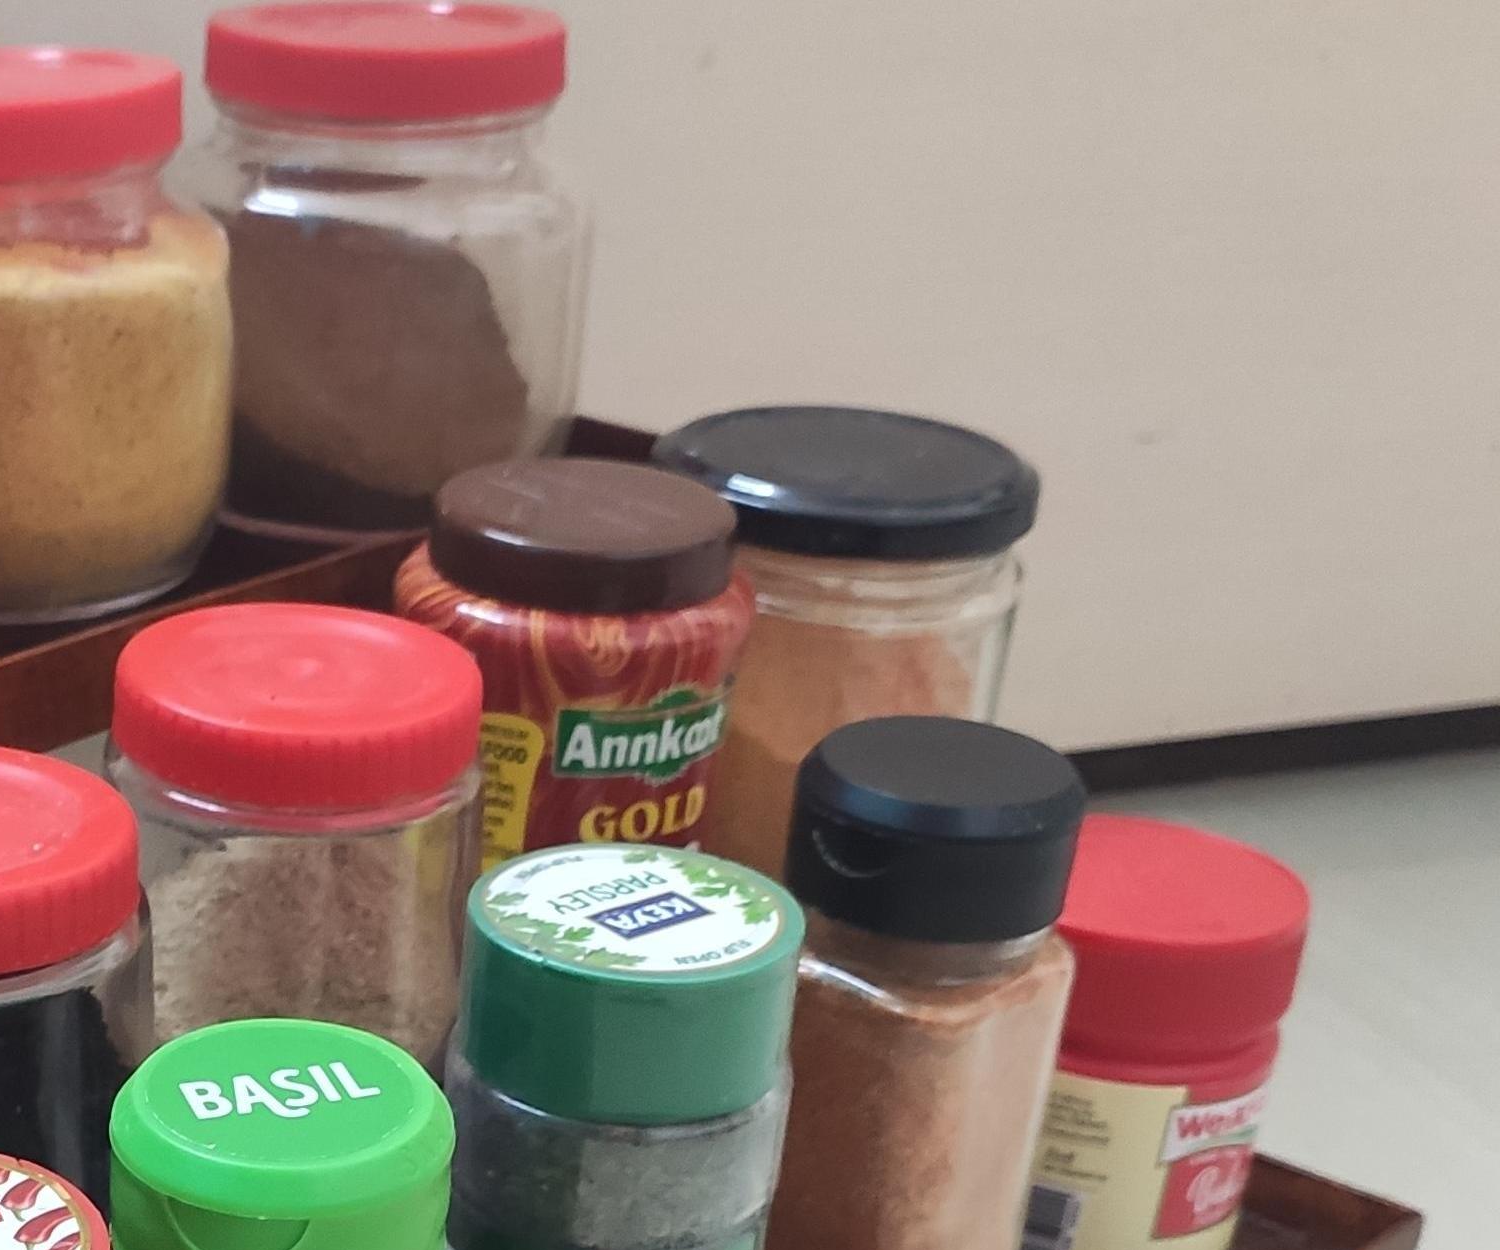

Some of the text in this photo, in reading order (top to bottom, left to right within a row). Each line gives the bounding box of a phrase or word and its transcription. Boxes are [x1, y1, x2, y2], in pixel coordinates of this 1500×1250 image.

[579, 784, 706, 843] GOLD
[547, 869, 668, 915] PARSLEY
[604, 897, 698, 932] KEYA
[178, 1061, 381, 1120] BASIL
